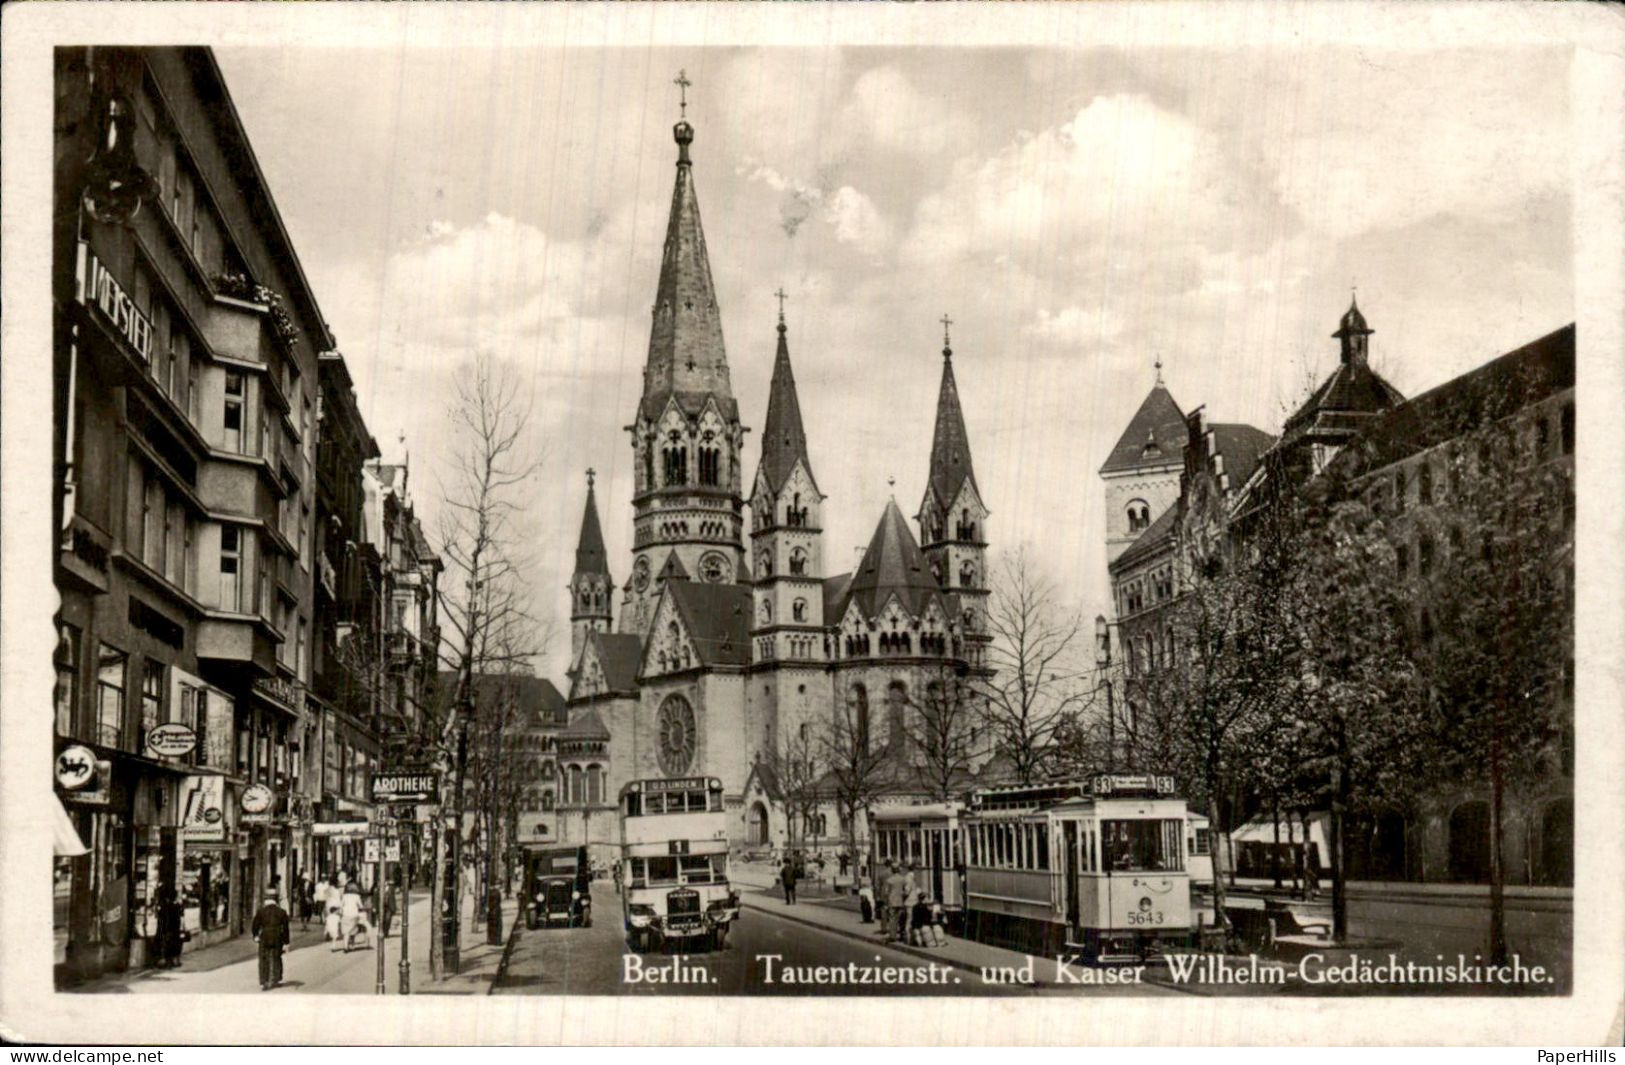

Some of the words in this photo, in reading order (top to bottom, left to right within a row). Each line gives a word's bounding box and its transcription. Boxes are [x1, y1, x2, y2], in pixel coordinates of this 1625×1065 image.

[1095, 777, 1110, 793] 93
[1158, 777, 1174, 792] 93
[675, 841, 682, 853] 1
[1128, 911, 1164, 925] 5643
